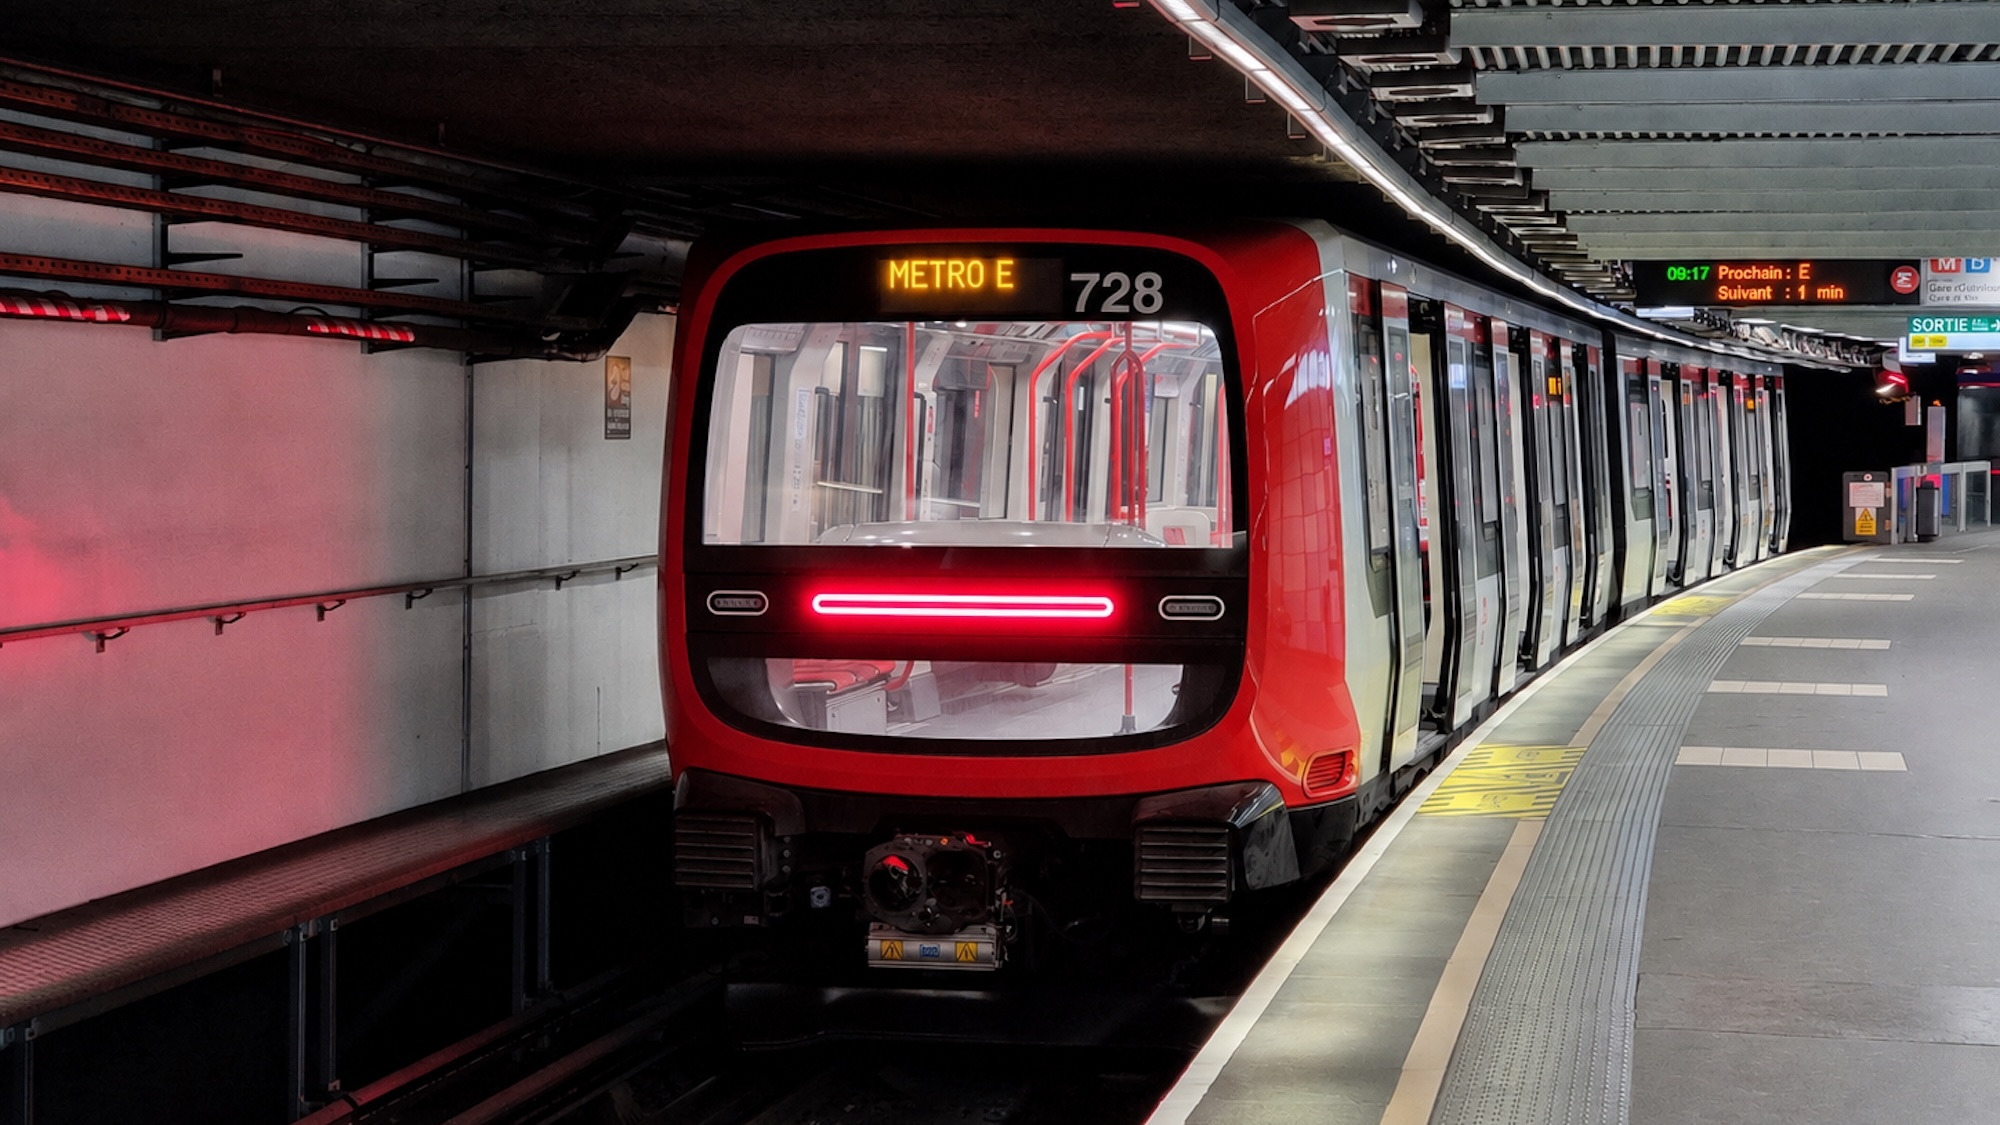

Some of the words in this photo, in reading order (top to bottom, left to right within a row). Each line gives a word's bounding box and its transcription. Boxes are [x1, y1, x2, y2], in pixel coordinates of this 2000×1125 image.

[889, 260, 985, 289] METRO
[997, 260, 1015, 289] E
[1667, 265, 1710, 282] 09:17
[1798, 264, 1811, 280] E
[1070, 271, 1164, 314] 728
[1717, 285, 1773, 301] Suivant
[1797, 286, 1807, 301] 1
[1817, 285, 1845, 301] min
[1912, 317, 1969, 332] SORTIE
